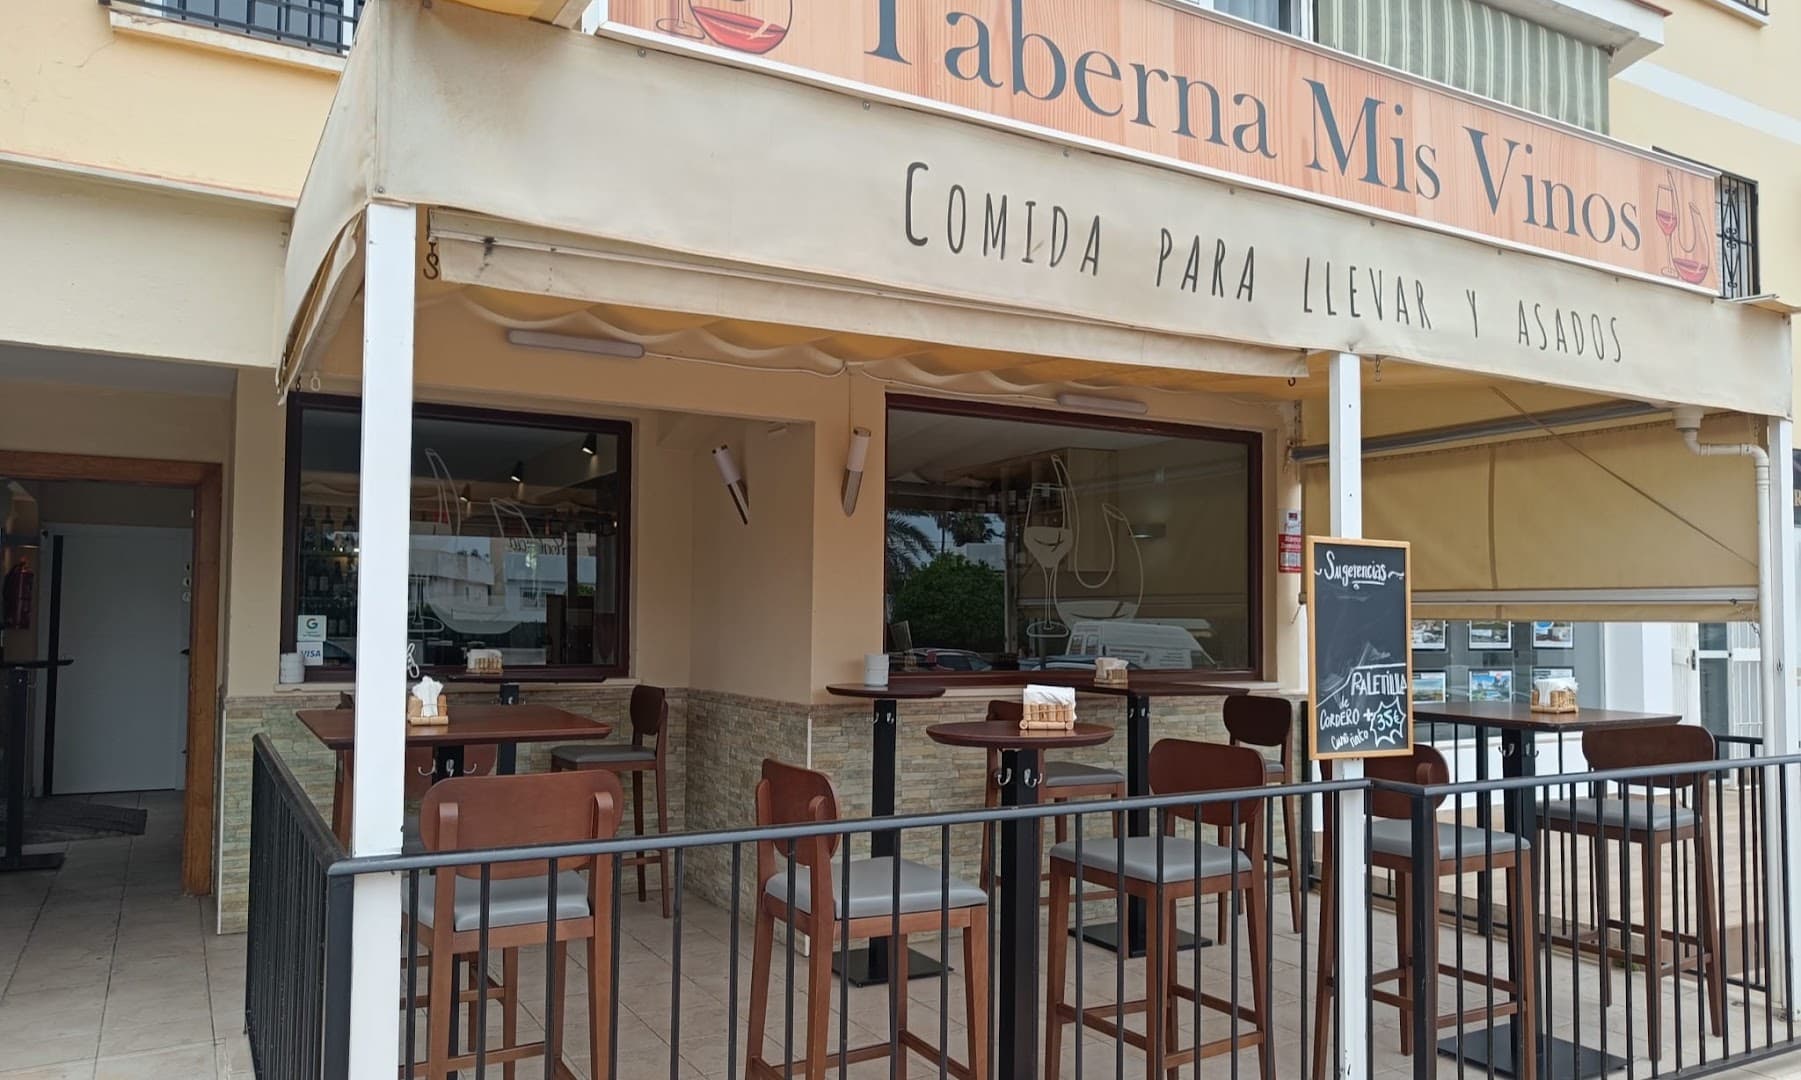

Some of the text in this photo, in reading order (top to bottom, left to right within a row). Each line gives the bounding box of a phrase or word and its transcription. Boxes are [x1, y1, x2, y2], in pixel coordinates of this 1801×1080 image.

[1303, 78, 1441, 200] Mis
[1463, 126, 1641, 251] Vinos
[1156, 228, 1255, 303] PARA
[1303, 257, 1432, 331] LLEVAR
[1466, 289, 1479, 338] Y
[1518, 300, 1622, 363] ASADOS
[1324, 550, 1387, 587] Sugerencias
[300, 650, 321, 658] VISA
[1339, 695, 1350, 709] de
[1320, 708, 1360, 731] CORDERO
[1377, 709, 1401, 731] 35€
